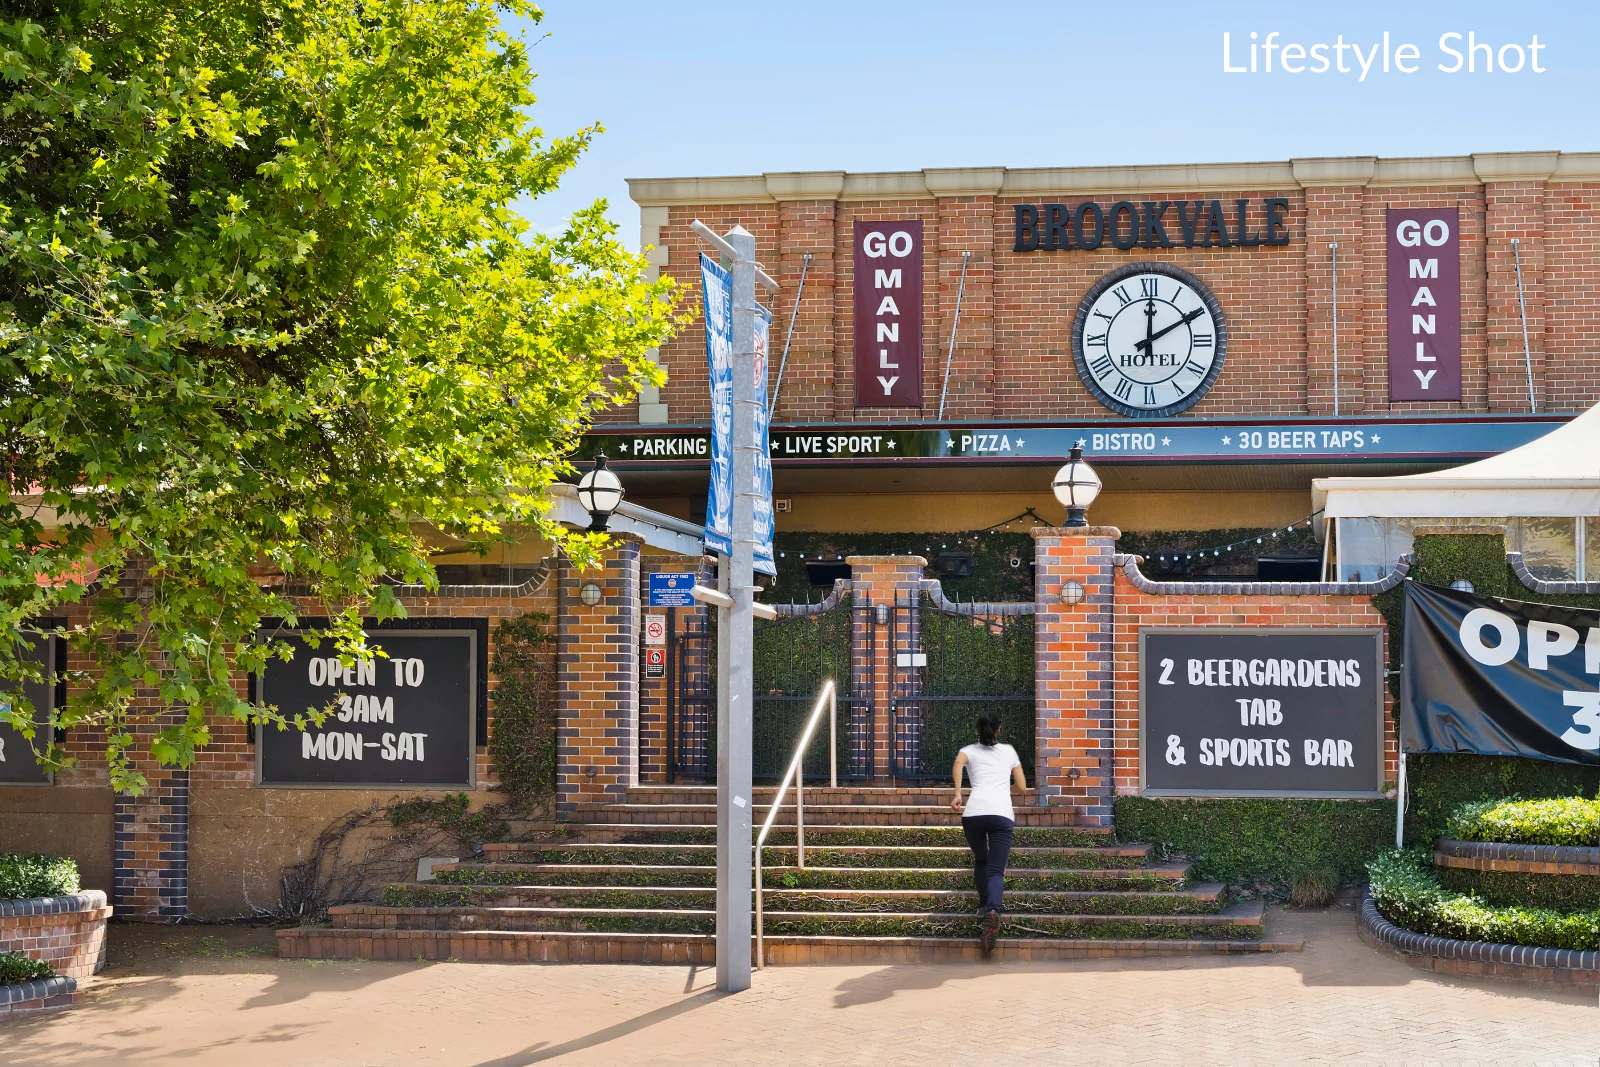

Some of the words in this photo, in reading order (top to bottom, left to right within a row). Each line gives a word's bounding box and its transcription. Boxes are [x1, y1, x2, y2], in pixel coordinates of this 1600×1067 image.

[1013, 198, 1290, 252] BROOKVALE
[1396, 220, 1450, 247] GO
[863, 231, 913, 258] GO
[874, 268, 902, 396] MANLY
[1409, 258, 1439, 390] MANLY
[1120, 353, 1180, 367] HOTEL
[633, 438, 708, 456] PARKING
[785, 437, 824, 454] LIVE
[826, 436, 883, 453] SPORT
[961, 434, 1011, 452] PIZZA
[1092, 433, 1156, 451] BISTRO
[1238, 432, 1262, 449] 30
[1267, 431, 1316, 449] BEER
[1320, 430, 1365, 448] TAPS
[308, 657, 376, 687] OPEN
[390, 657, 425, 688] TO
[1158, 657, 1175, 685] 2
[1187, 658, 1361, 688] BEERGARDENS
[337, 694, 394, 724] 3AM
[1235, 698, 1284, 726] TAB
[1560, 690, 1600, 750] 3
[302, 731, 428, 762] MON-SAT
[1165, 734, 1187, 766] &
[1199, 738, 1291, 767] SPORTS
[1304, 739, 1355, 768] BAR
